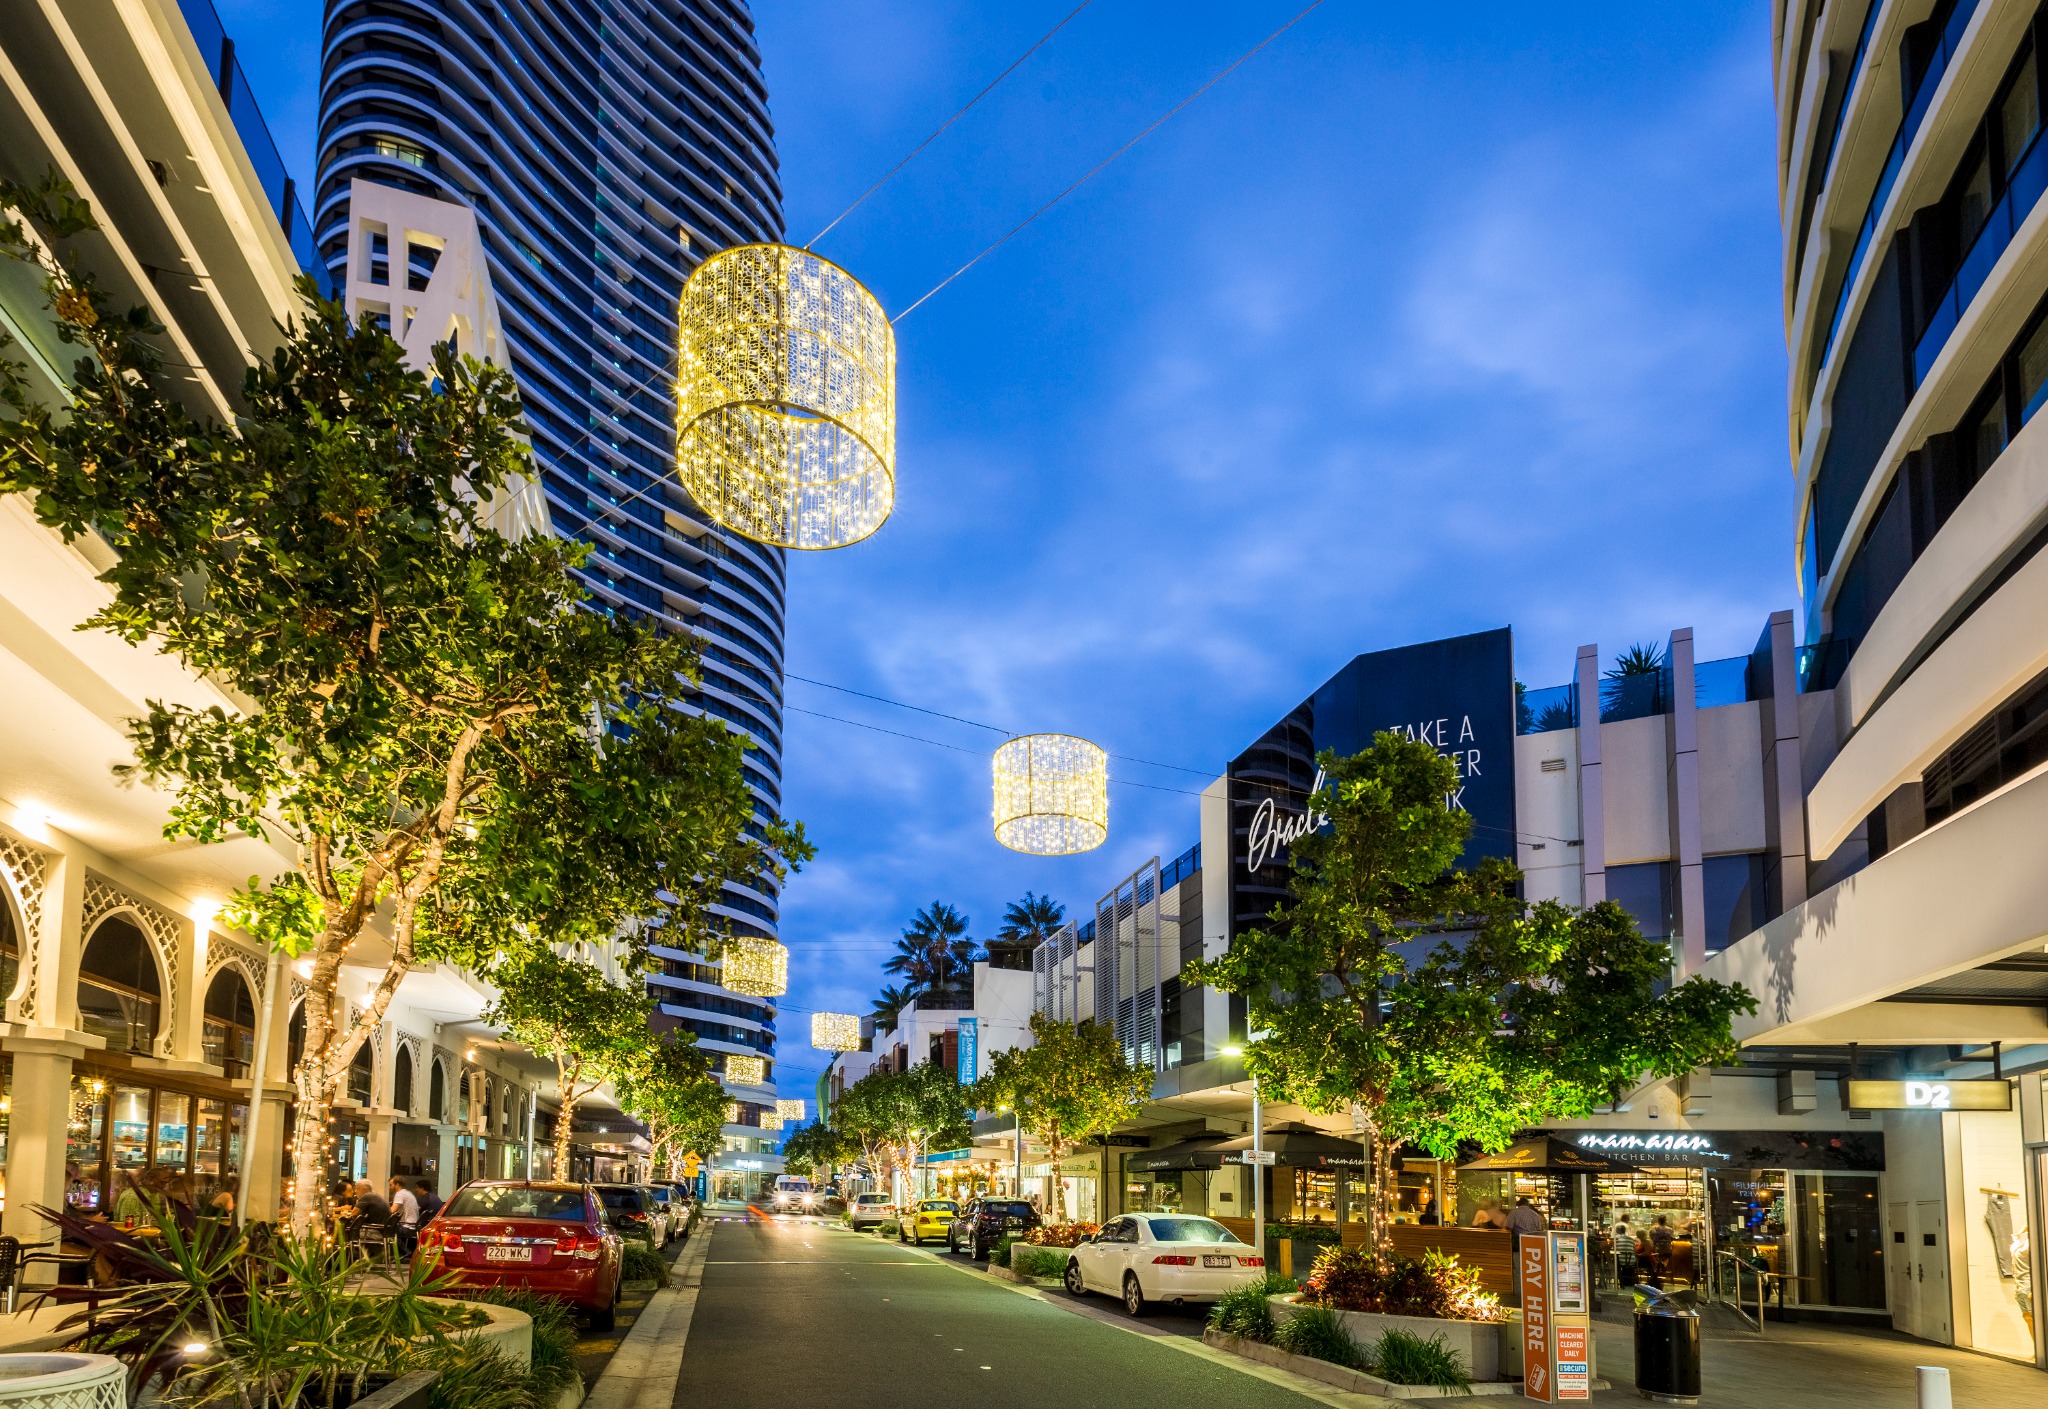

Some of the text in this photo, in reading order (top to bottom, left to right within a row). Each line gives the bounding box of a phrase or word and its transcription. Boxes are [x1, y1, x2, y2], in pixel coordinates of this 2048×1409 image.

[1459, 715, 1474, 743] A
[1905, 1081, 1950, 1109] D2
[1578, 1134, 1711, 1150] mamasan
[1664, 1153, 1689, 1162] BAR
[1525, 1247, 1544, 1353] PAY HERE
[1559, 1332, 1584, 1340] MACHINE
[1560, 1341, 1584, 1349] CLEARED
